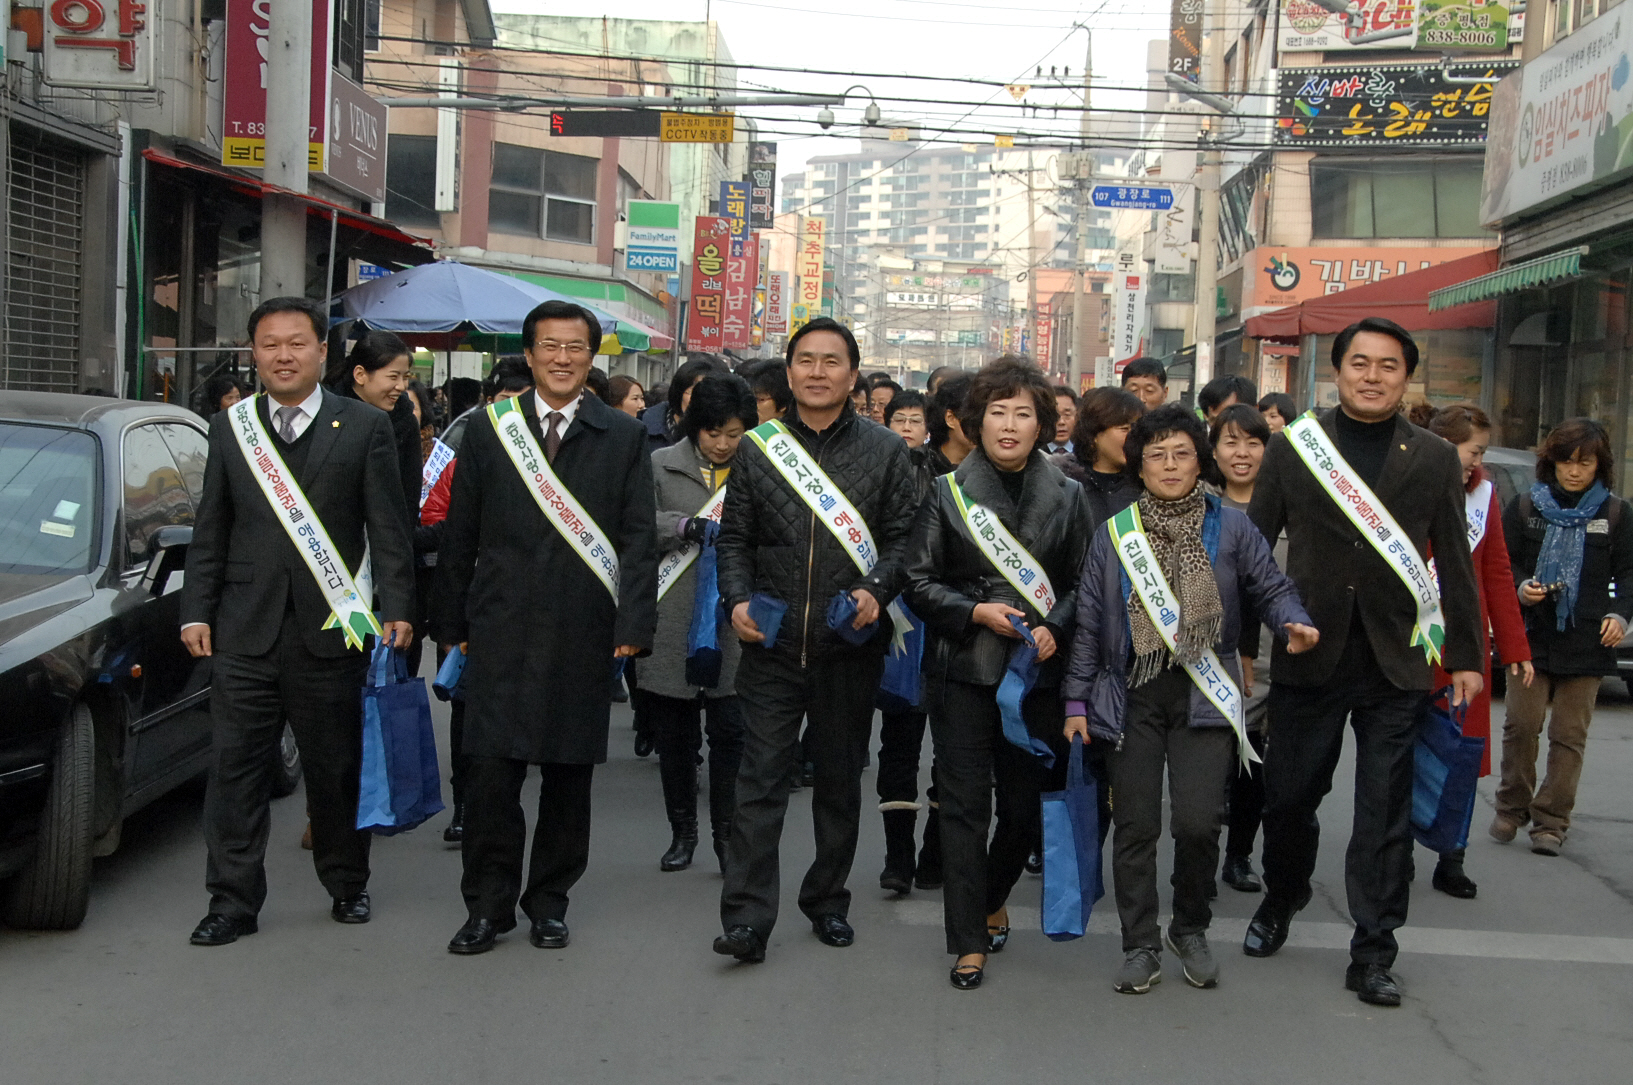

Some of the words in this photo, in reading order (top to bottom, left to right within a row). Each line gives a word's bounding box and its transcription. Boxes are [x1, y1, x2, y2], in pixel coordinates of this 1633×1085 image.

[1173, 57, 1192, 72] 2F
[1426, 30, 1497, 45] 838-8006
[349, 102, 378, 151] VENUS
[666, 129, 698, 140] CCTV
[700, 129, 728, 141] 작동중
[1533, 66, 1611, 163] 임실치즈피자
[726, 184, 747, 235] 노래방
[1095, 192, 1109, 201] 107
[1117, 188, 1151, 200] 광장로
[1160, 195, 1171, 204] 111
[630, 231, 676, 243] FamilyMart
[728, 243, 754, 258] 용실
[803, 220, 822, 301] 척추교정
[724, 259, 748, 339] 김남숙
[769, 274, 782, 315] 또래오래
[1124, 292, 1136, 354] 삼천리자전거
[771, 439, 837, 511] 전통시장을
[298, 522, 345, 590] 애용합시다
[971, 508, 1036, 586] 전통시장을
[1388, 539, 1433, 604] 애용합시다
[1124, 538, 1177, 627] 전통시장을
